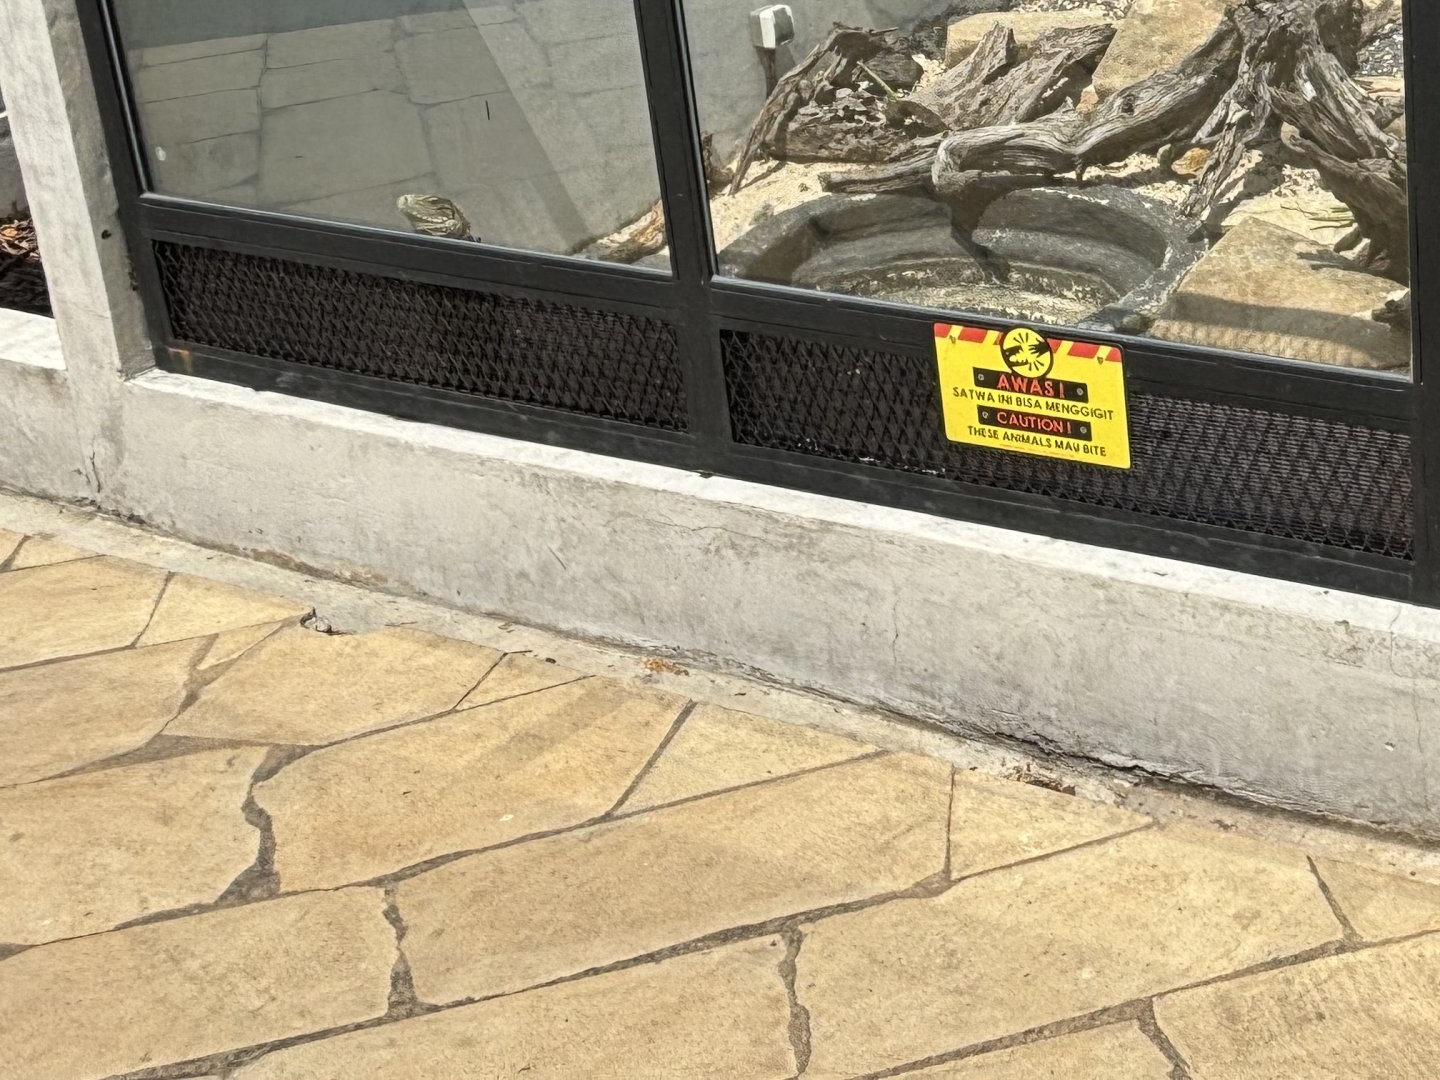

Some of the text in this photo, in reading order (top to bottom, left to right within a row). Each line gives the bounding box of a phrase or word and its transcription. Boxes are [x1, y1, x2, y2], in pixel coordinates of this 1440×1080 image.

[952, 387, 1114, 421] SATWA INI BISA MENGGIGIT
[967, 425, 999, 440] THESE
[1002, 431, 1052, 448] ANIMALS
[1082, 445, 1107, 457] BITE
